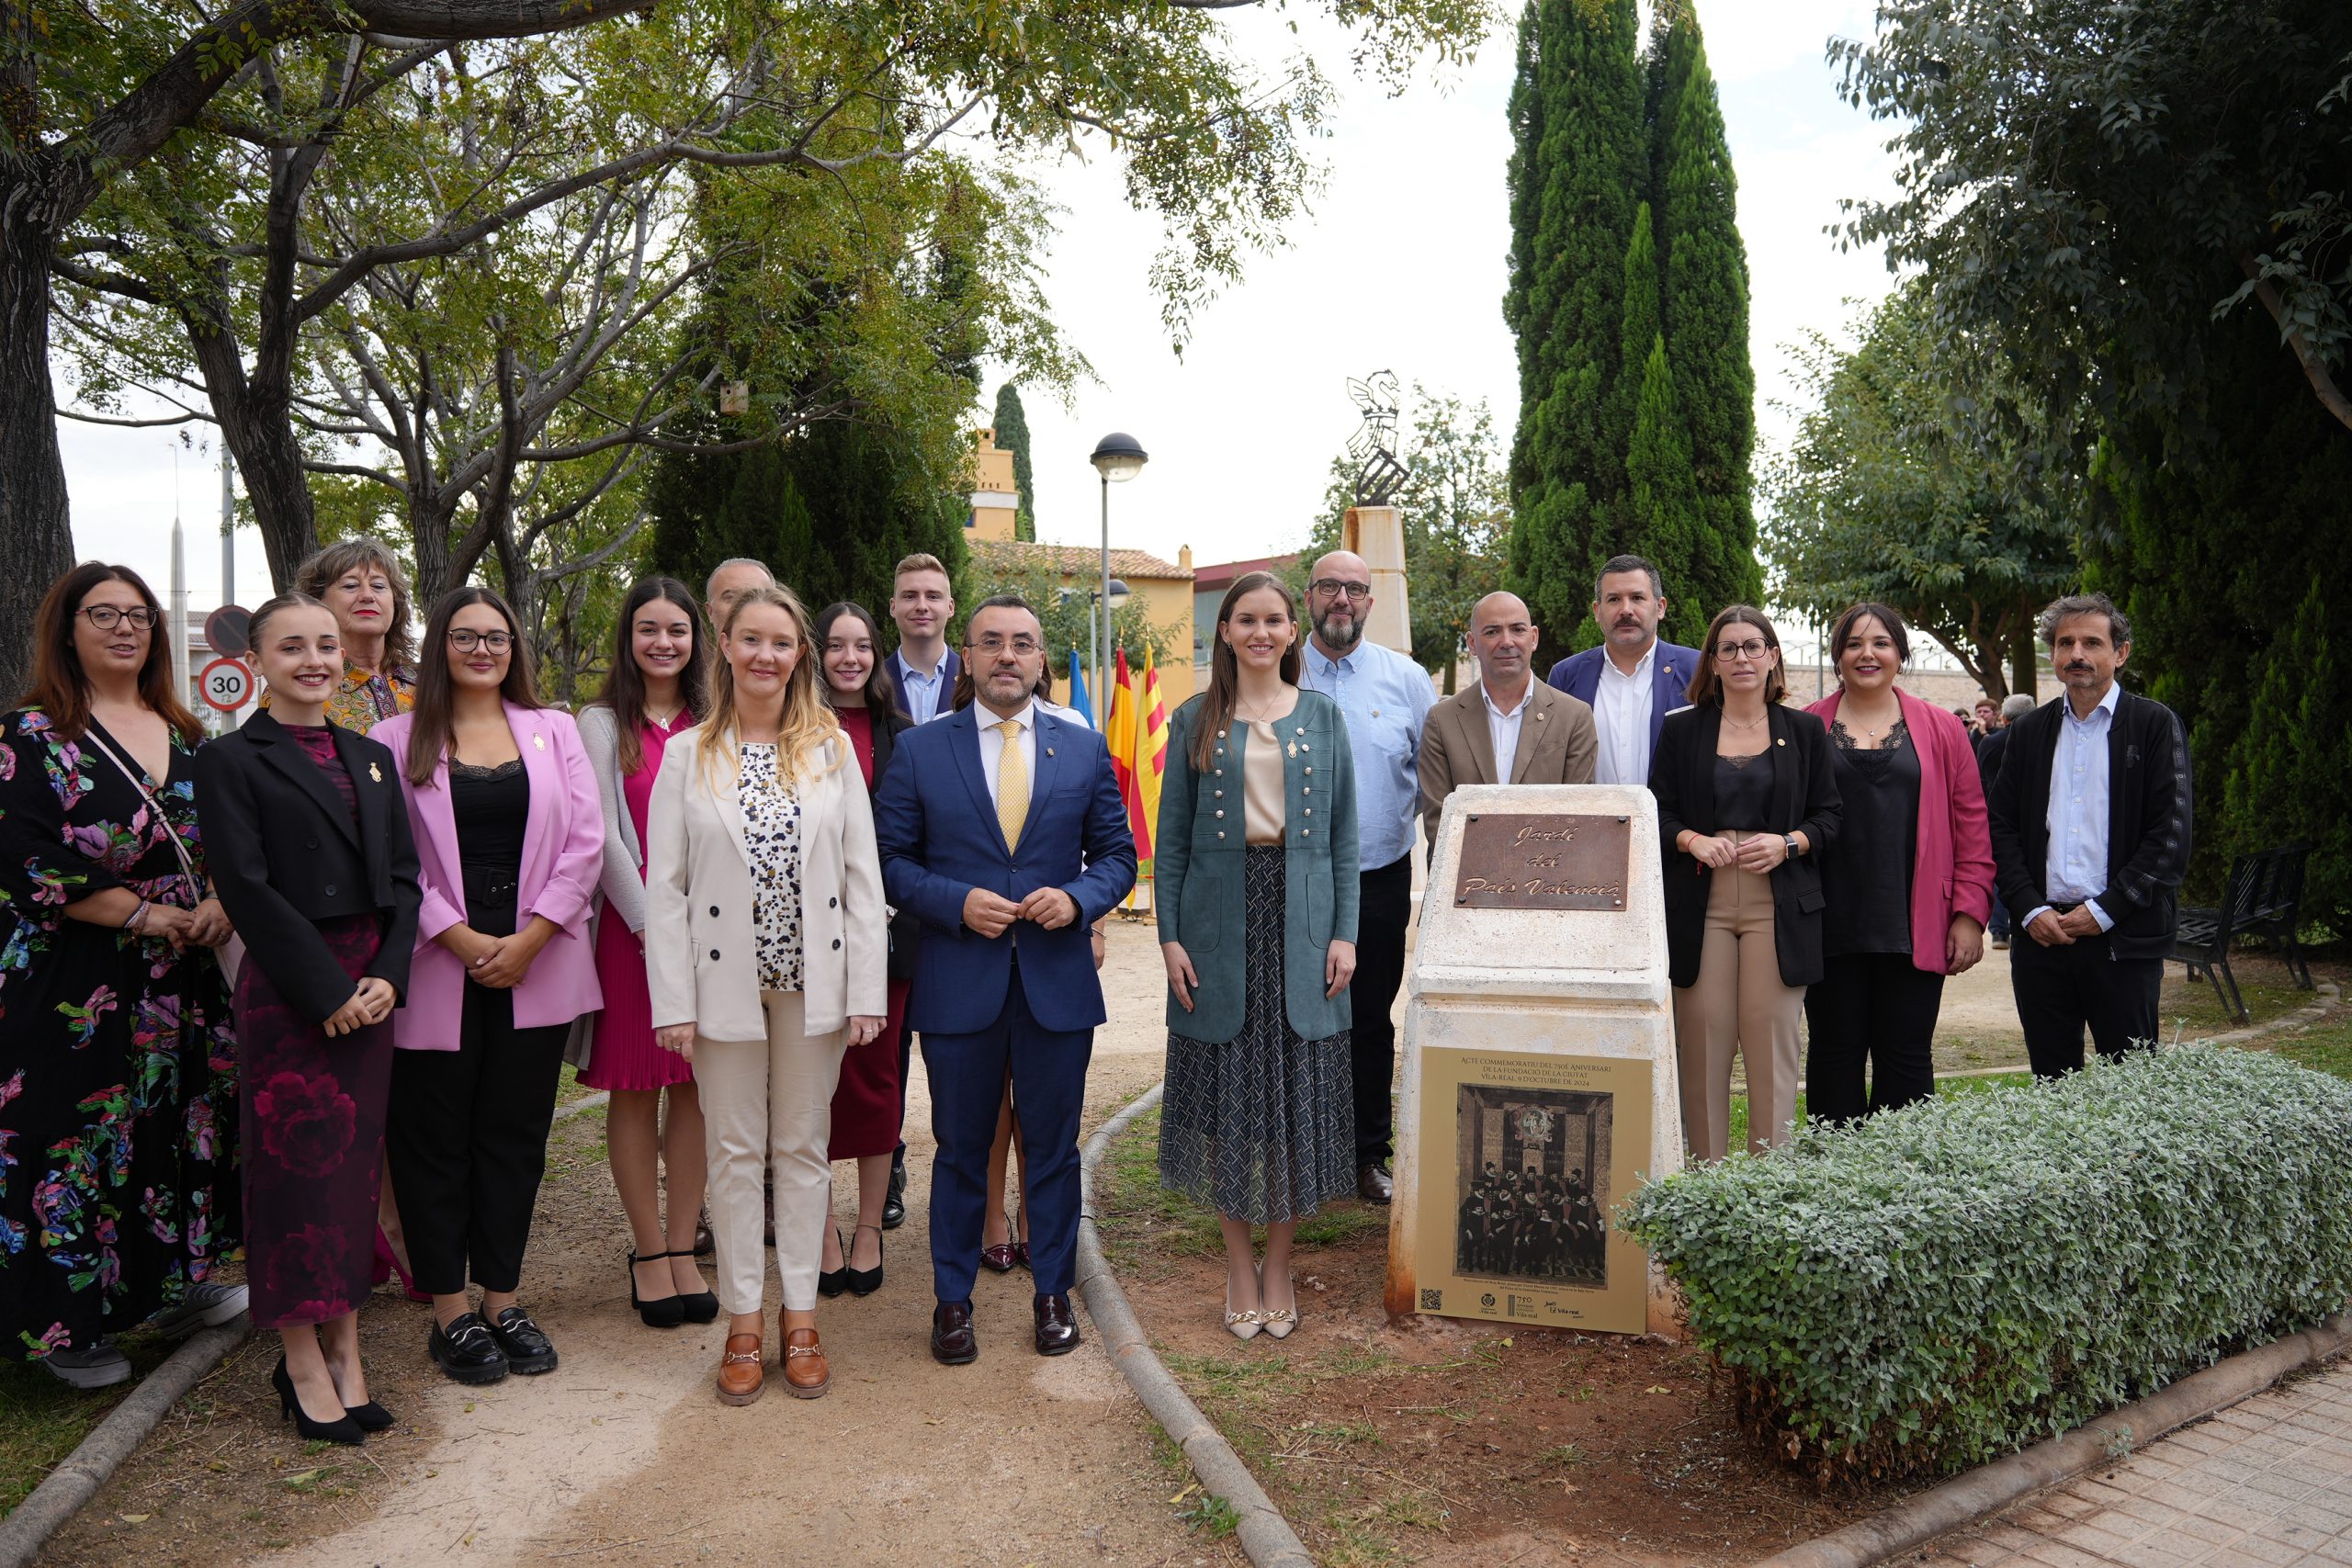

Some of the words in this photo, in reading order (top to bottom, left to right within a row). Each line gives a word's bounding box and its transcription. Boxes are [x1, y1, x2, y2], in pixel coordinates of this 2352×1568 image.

[212, 676, 241, 694] 30
[1513, 825, 1579, 846] Jardí
[1526, 852, 1562, 868] del
[1464, 877, 1515, 896] País
[1524, 877, 1620, 897] Valencià
[1479, 1058, 1538, 1067] COMMEMORATIU
[1570, 1064, 1611, 1073] ANIVERSARI
[1516, 1295, 1532, 1303] 750
